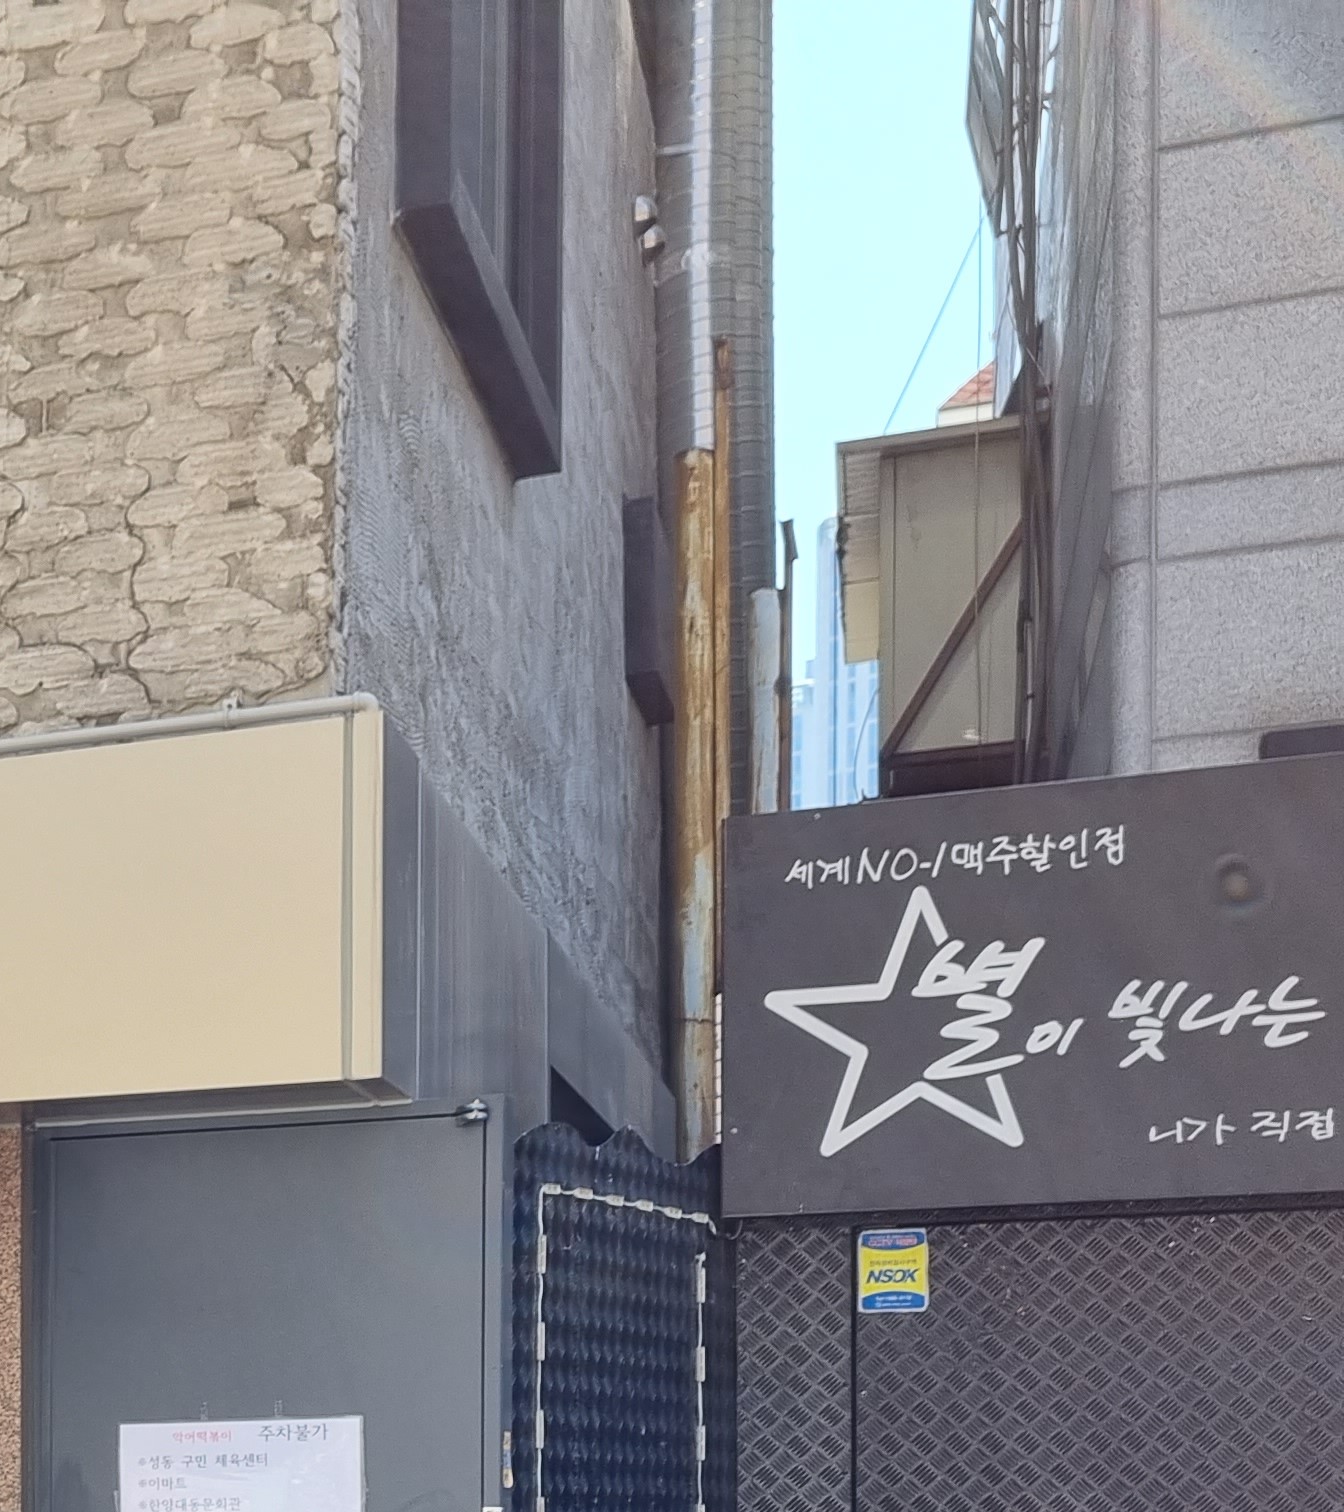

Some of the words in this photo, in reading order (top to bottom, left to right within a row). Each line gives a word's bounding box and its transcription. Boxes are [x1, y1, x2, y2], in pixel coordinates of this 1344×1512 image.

[1108, 976, 1326, 1069] 빛나는
[1251, 1106, 1336, 1142] 직접
[866, 1267, 921, 1285] NSOK
[172, 1429, 232, 1443] 악어떡볶이
[257, 1422, 329, 1442] 주차불가
[180, 1454, 207, 1469] 구민
[214, 1453, 268, 1468] 체육센터
